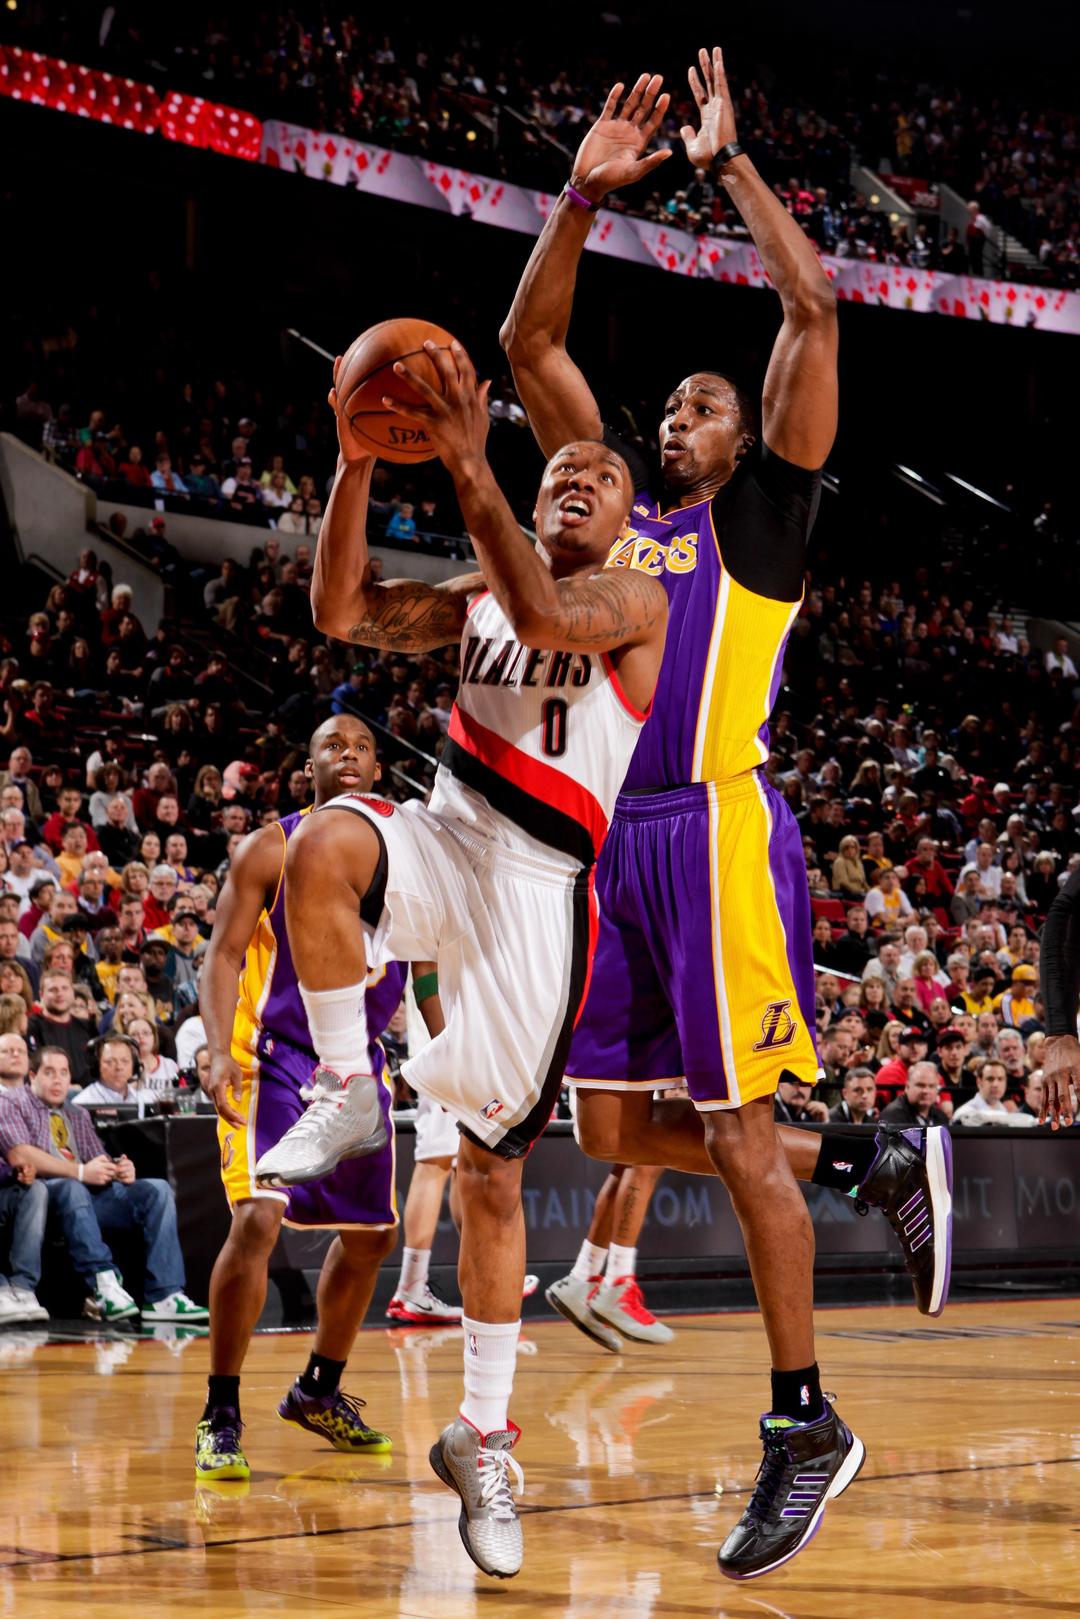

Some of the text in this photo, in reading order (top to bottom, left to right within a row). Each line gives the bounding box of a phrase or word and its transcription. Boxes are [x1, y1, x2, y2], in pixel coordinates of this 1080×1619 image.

[388, 426, 431, 444] SPA
[602, 527, 699, 576] LAKES
[541, 697, 567, 757] 0
[952, 1175, 995, 1219] IT
